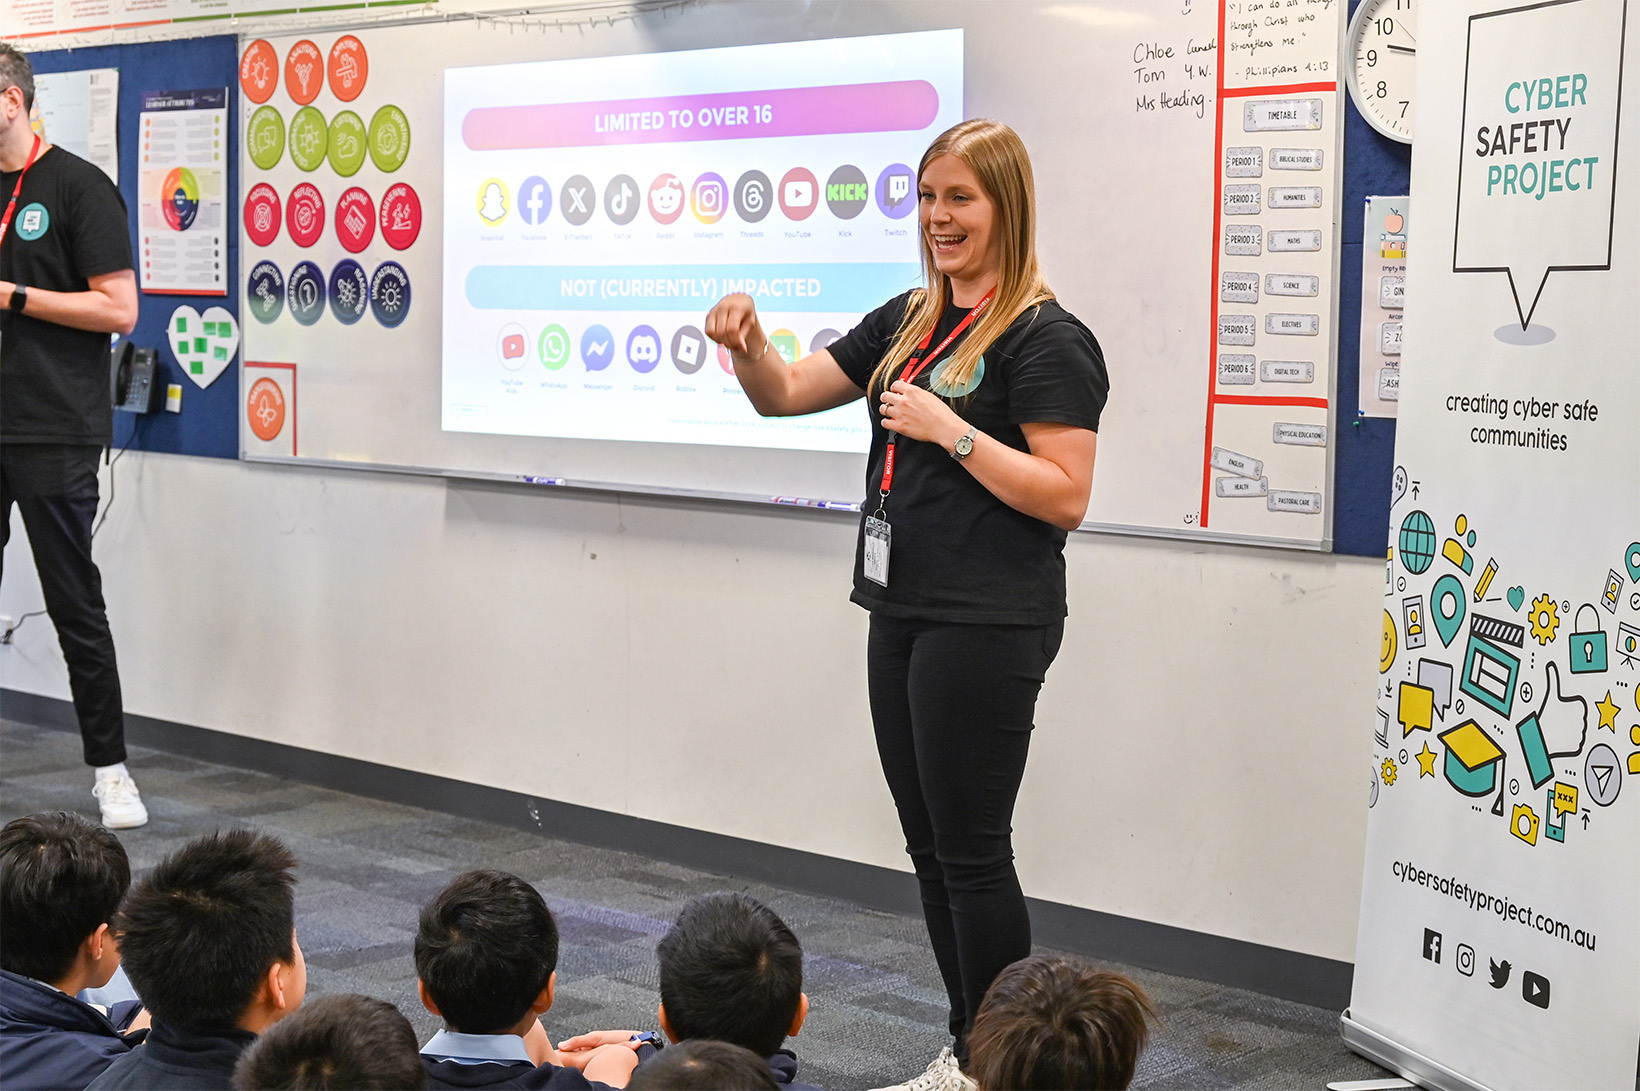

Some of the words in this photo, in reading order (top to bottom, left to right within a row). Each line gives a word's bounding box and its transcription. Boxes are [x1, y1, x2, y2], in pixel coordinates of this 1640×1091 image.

[1248, 3, 1264, 12] can
[1270, 1, 1280, 9] do
[1298, 13, 1315, 23] who
[1374, 17, 1394, 36] 10
[1133, 42, 1175, 63] Chloe
[1366, 49, 1378, 68] 9
[1133, 66, 1166, 84] Tom
[1376, 80, 1388, 99] 8
[1505, 73, 1588, 114] CYBER
[1136, 94, 1156, 112] Mrs
[1268, 110, 1297, 120] TIMETABLE
[1398, 101, 1410, 119] 7
[595, 111, 664, 132] LIMITED
[669, 109, 694, 128] TO
[698, 106, 749, 127] OVER
[753, 104, 772, 124] 16
[1476, 117, 1572, 158] SAFETY
[1231, 157, 1251, 166] PERIOD
[1487, 156, 1599, 201] PROJECT
[827, 183, 867, 201] KICK
[1229, 195, 1249, 204] PERIOD
[740, 230, 764, 238] Threads
[784, 230, 812, 239] YouTube
[838, 229, 853, 238] Kick
[885, 228, 908, 237] Twitch
[1230, 235, 1250, 244] PERIOD
[1382, 265, 1398, 273] Empty
[561, 279, 597, 297] NOT
[601, 277, 718, 300] (CURRENTLY)
[722, 277, 822, 297] IMPACTED
[1227, 281, 1248, 291] PERIOD
[1283, 282, 1300, 290] SCIENCE
[1223, 325, 1244, 334] PERIOD
[933, 336, 953, 355] VISITOR
[1224, 364, 1244, 373] PERIOD
[1289, 368, 1300, 376] TECH
[1446, 393, 1509, 420] creating
[1513, 396, 1559, 421] cyber
[1563, 399, 1599, 422] safe
[1280, 430, 1298, 438] PHYSICAL
[1298, 431, 1321, 439] EDUCATION
[1470, 426, 1568, 451] communities
[885, 449, 893, 475] VISITOR
[1228, 458, 1244, 469] ENGLISH
[1278, 497, 1299, 506] PASTORAL
[1299, 498, 1310, 506] CARE
[1392, 860, 1597, 952] cybersafetyproject.com.au
